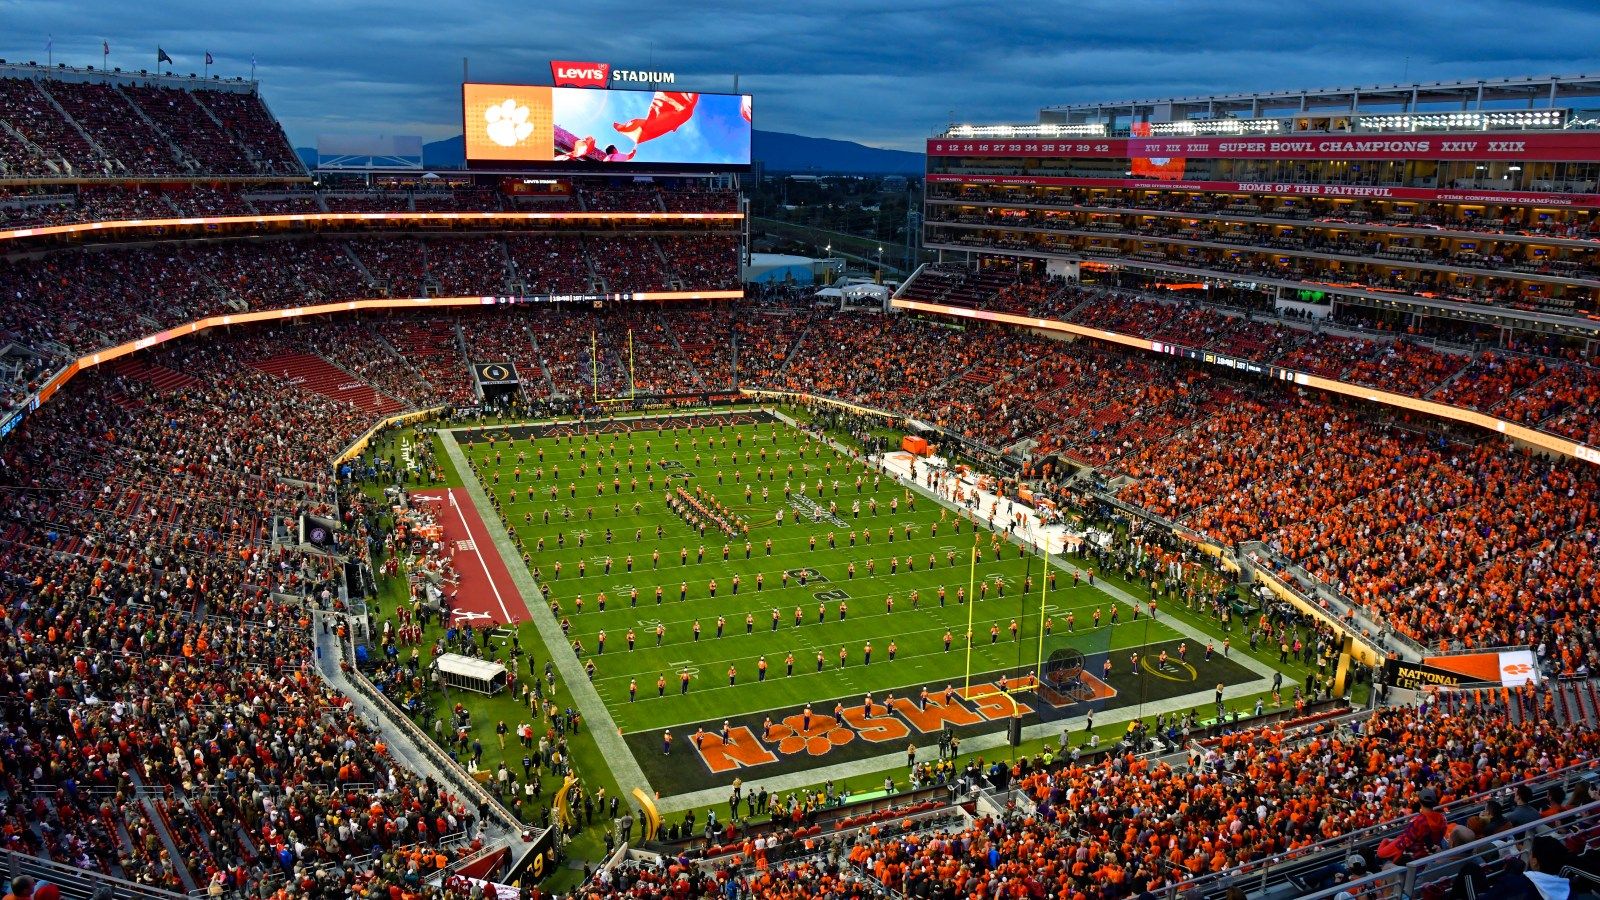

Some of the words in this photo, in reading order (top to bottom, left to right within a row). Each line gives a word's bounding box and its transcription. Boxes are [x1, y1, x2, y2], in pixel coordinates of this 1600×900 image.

[612, 70, 675, 83] STADIUM
[936, 144, 942, 152] 8
[949, 144, 959, 152] 12
[964, 144, 974, 152] 14
[979, 144, 989, 152] 16
[994, 144, 1006, 152] 27
[1009, 144, 1021, 152] 33
[1025, 144, 1038, 152] 34
[1042, 144, 1055, 152] 35
[1059, 144, 1072, 152] 37
[1076, 144, 1090, 152] 39
[1094, 144, 1109, 152] 42
[1145, 144, 1160, 152] XVI
[1165, 144, 1181, 152] XIX
[1187, 144, 1209, 152] XXIII
[1219, 142, 1268, 152] SUPER
[1270, 142, 1315, 152] BOWL
[1319, 141, 1430, 152] CHAMPIONS
[1441, 141, 1478, 152] XXIV
[1487, 141, 1526, 152] XXIX
[1238, 183, 1272, 192] HOME
[1275, 184, 1291, 193] OF
[1294, 185, 1319, 194] THE
[1324, 186, 1392, 197] FAITHFUL
[1464, 195, 1517, 203] CONFERENCE
[1519, 197, 1571, 205] CHAMPIONS
